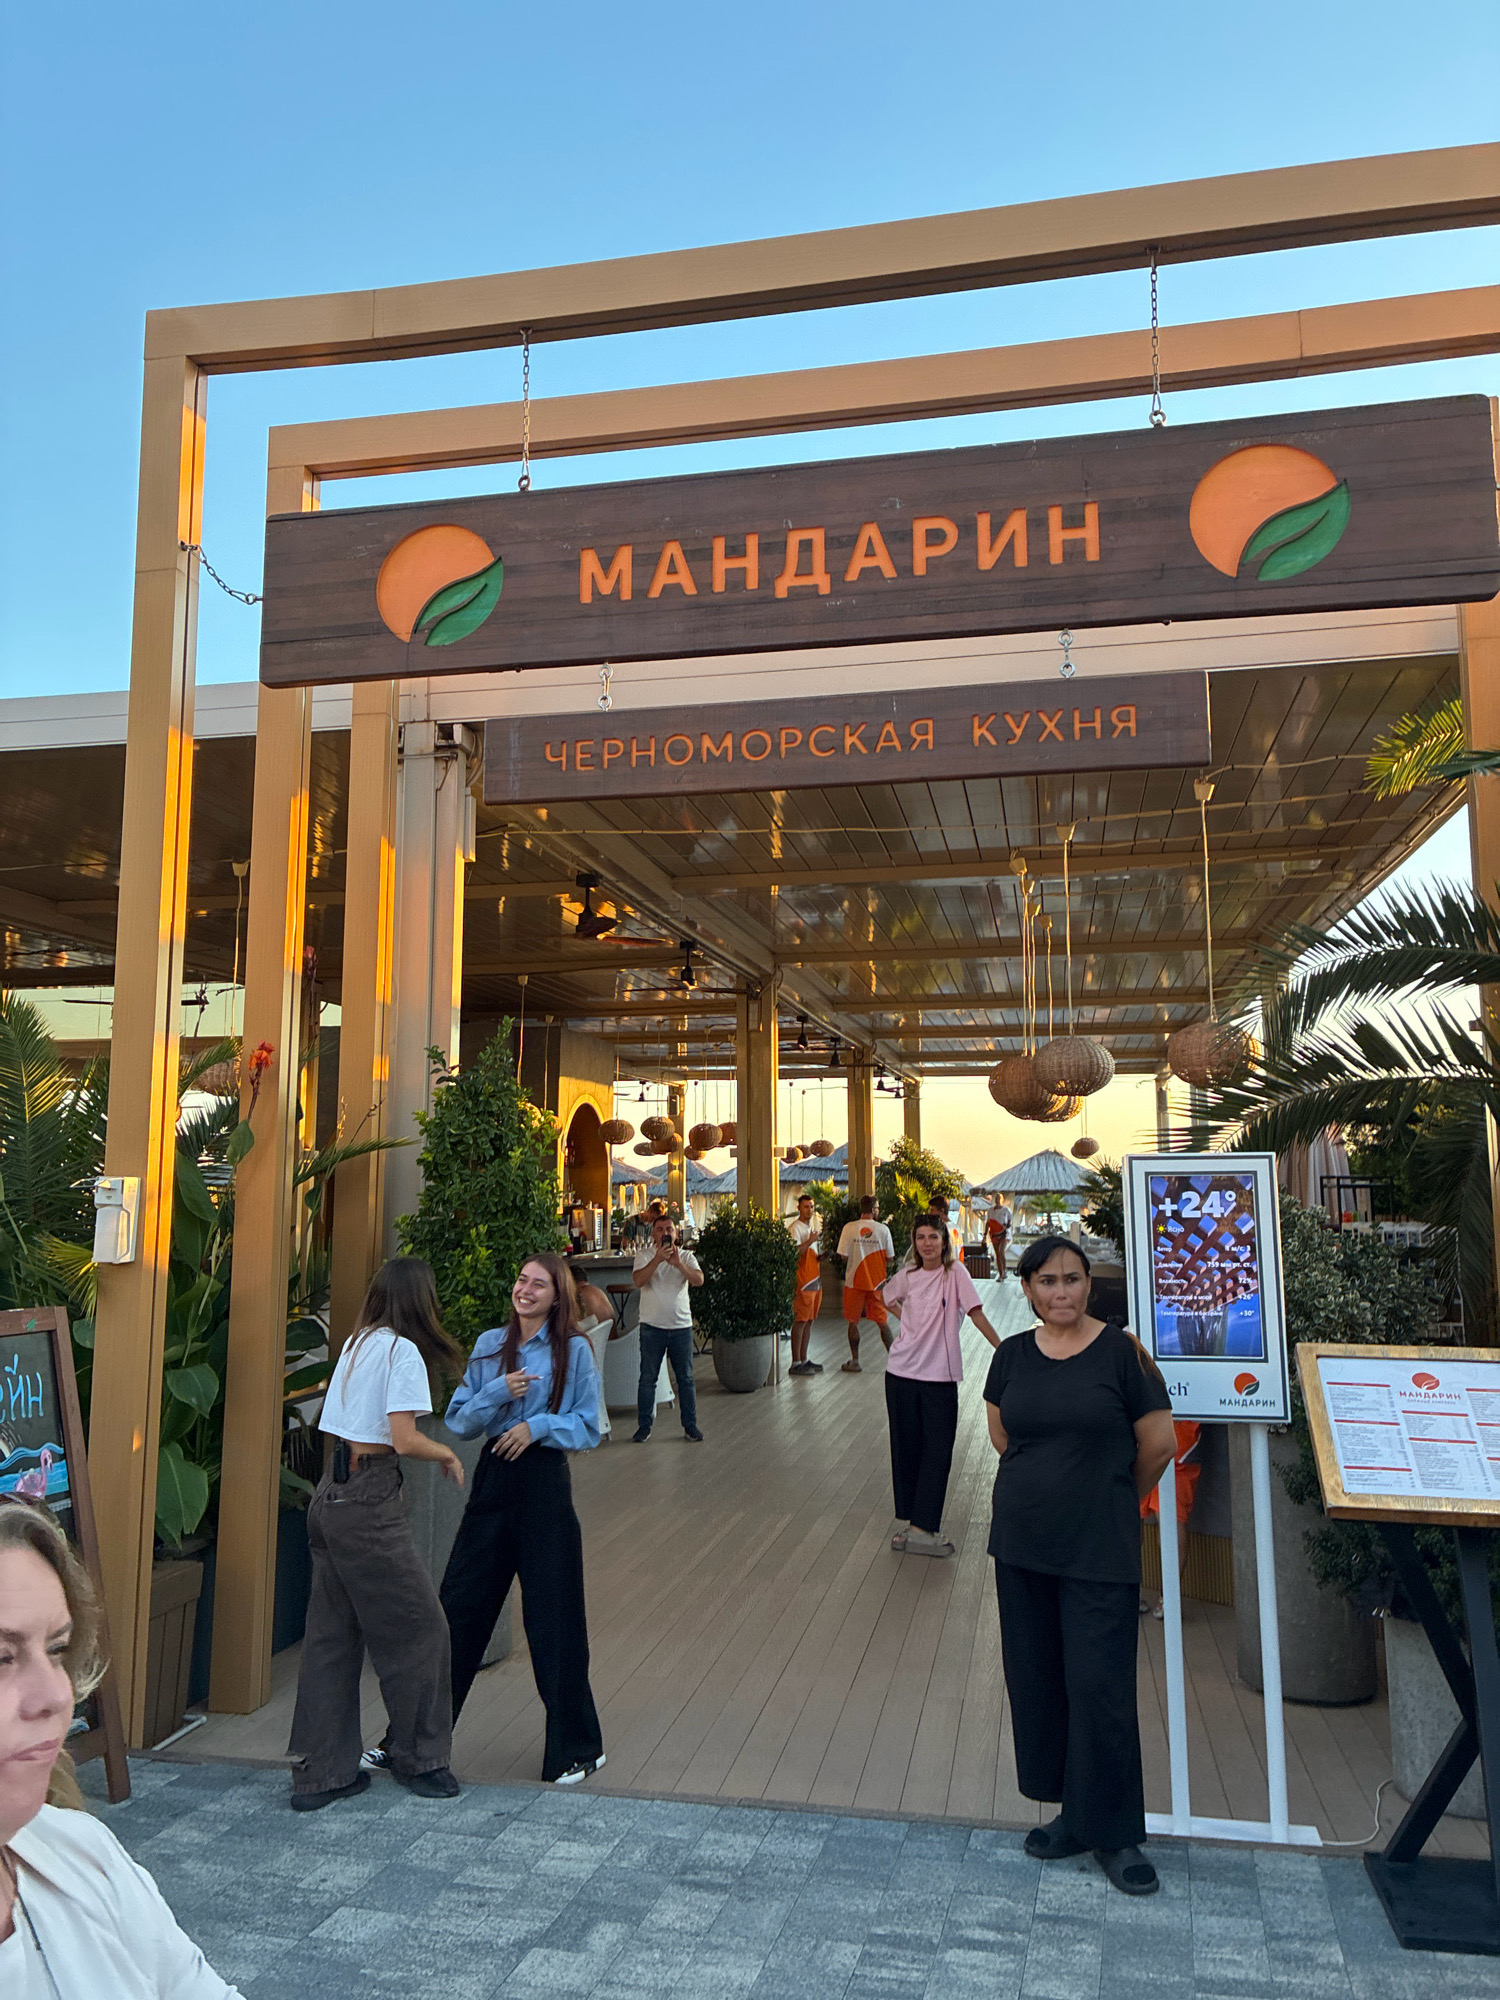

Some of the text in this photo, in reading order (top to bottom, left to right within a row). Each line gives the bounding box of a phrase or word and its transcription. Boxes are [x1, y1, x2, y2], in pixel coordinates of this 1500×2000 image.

[579, 501, 1100, 604] МАНДАРИН
[544, 704, 1137, 772] ЧЕРНОМОРСКАЯ КУХНЯ
[1158, 1190, 1237, 1218] +24°
[1168, 1382, 1188, 1397] ch
[1399, 1391, 1461, 1400] МАНДАРИН
[1219, 1398, 1276, 1408] МАНДАРИН
